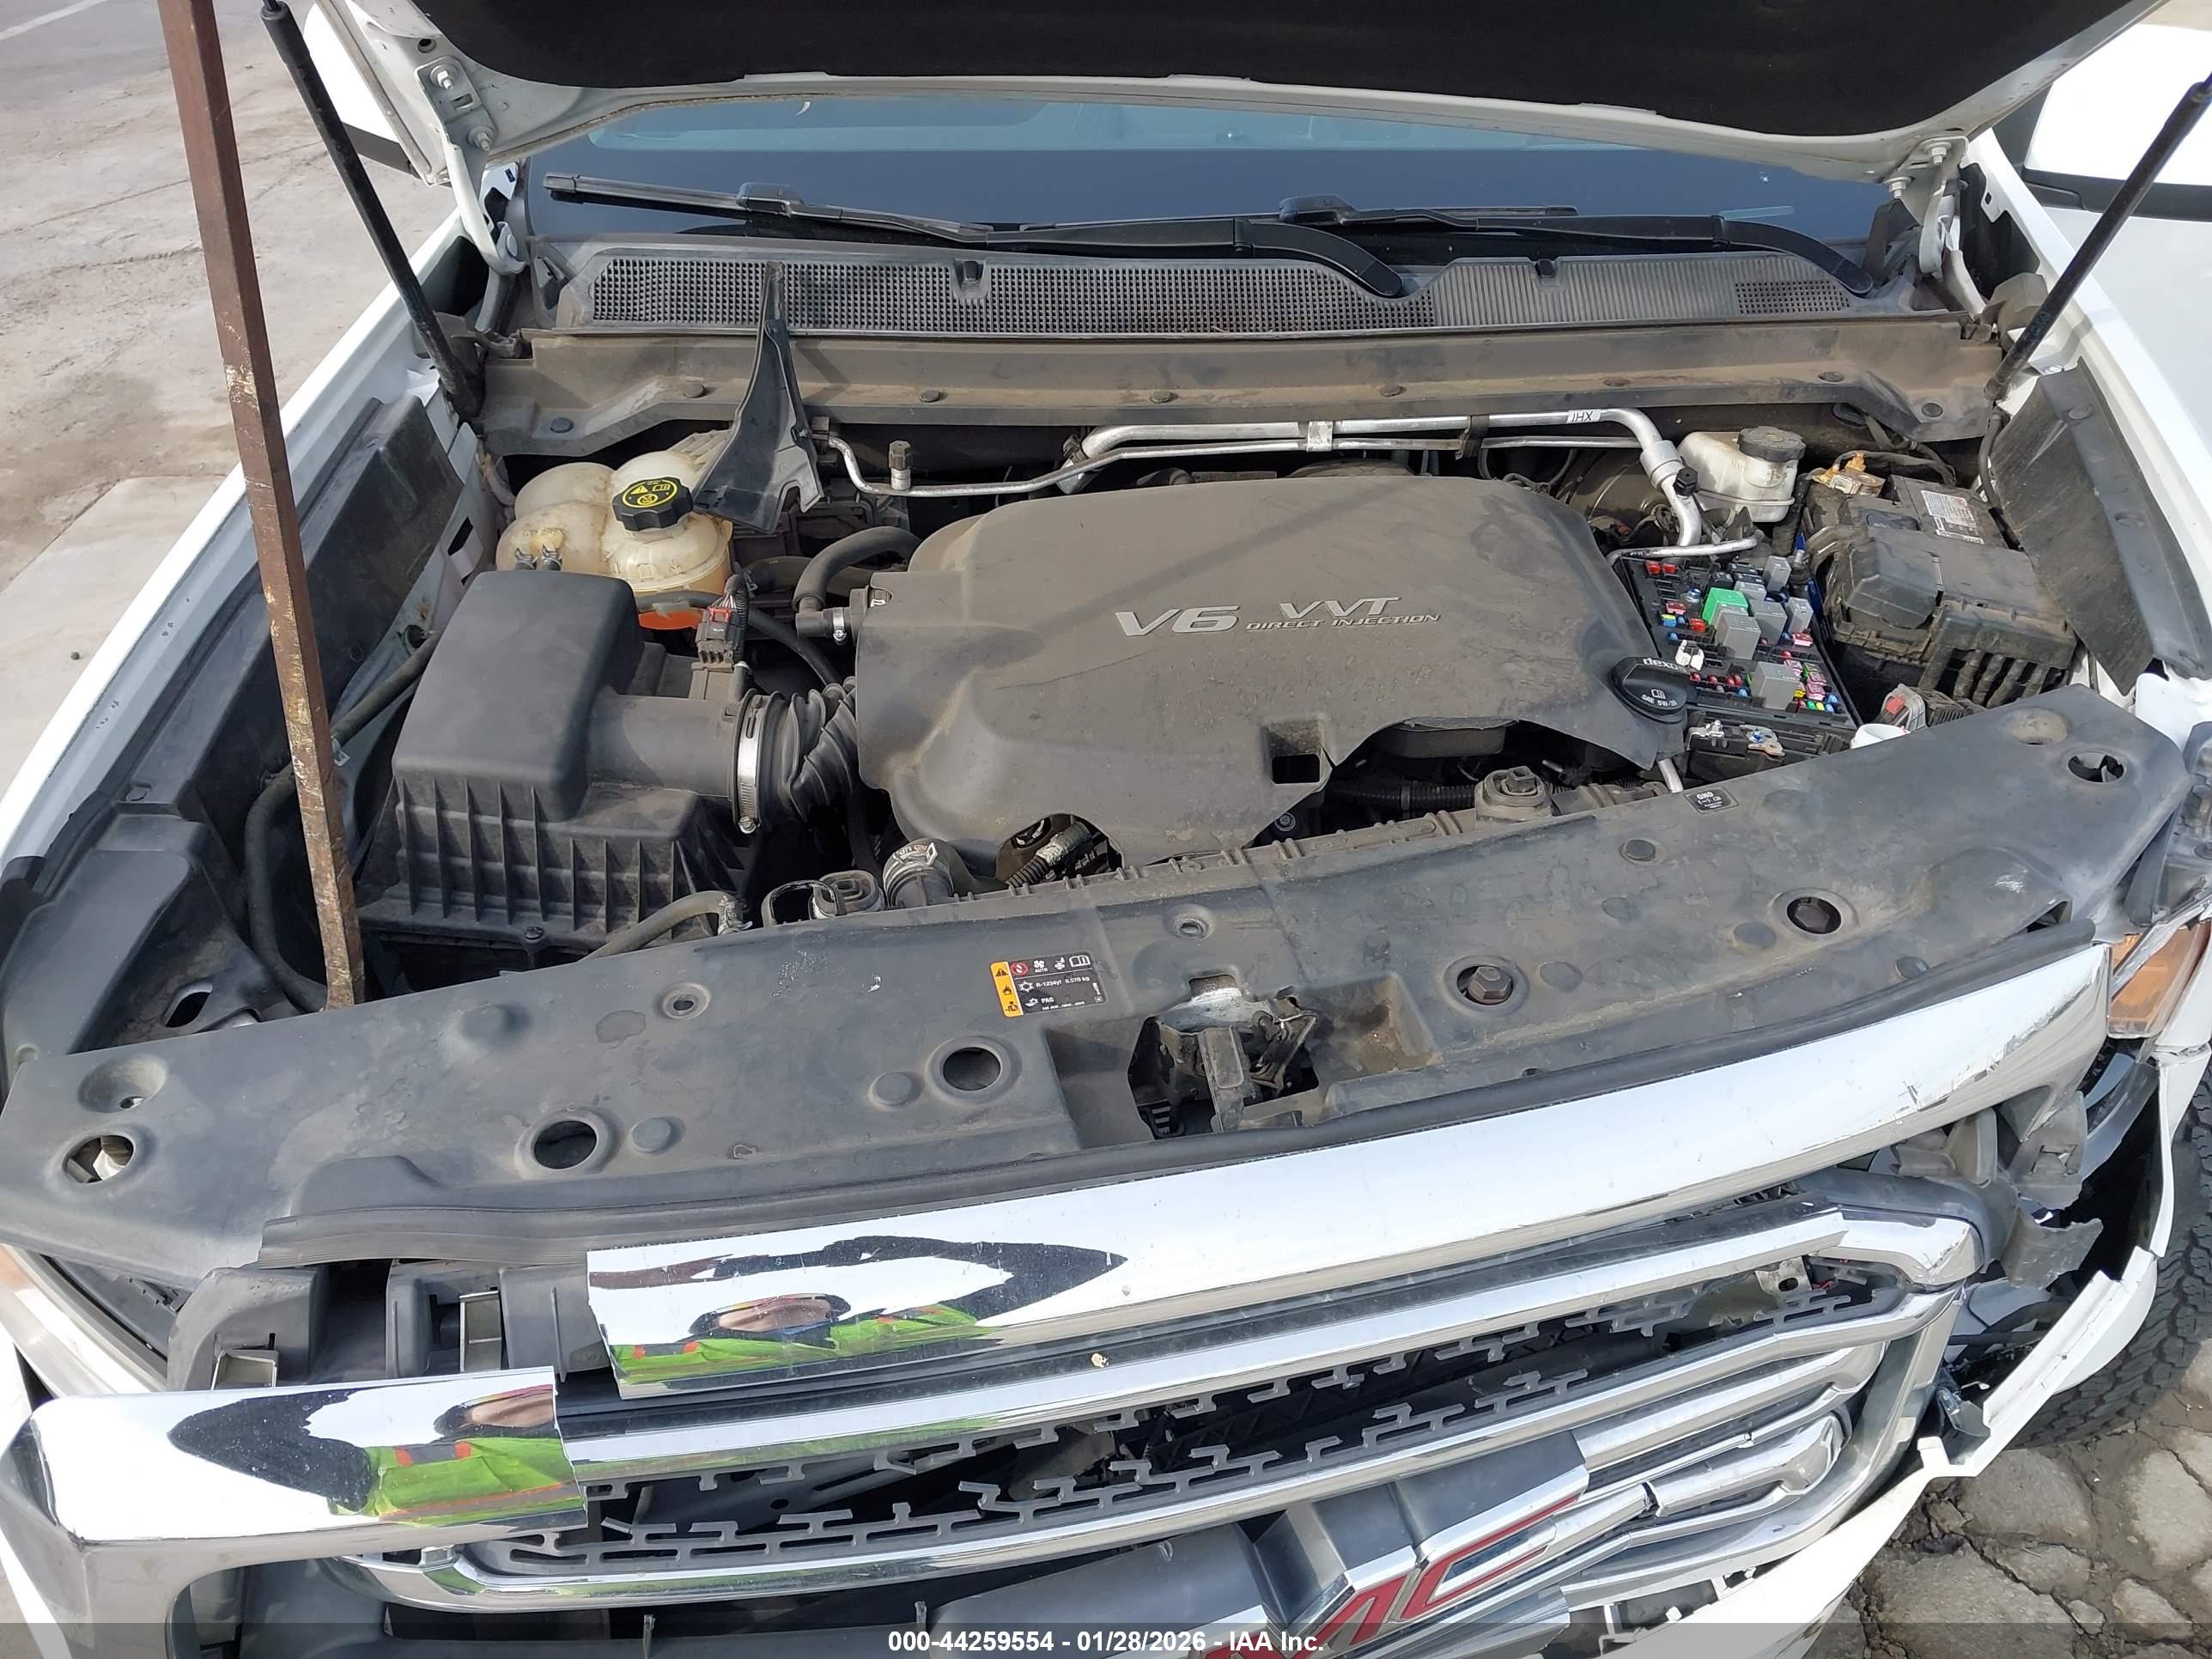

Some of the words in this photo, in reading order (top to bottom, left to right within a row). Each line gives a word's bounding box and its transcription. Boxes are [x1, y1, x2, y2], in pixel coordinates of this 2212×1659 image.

[1114, 605, 1241, 636] V6
[1279, 596, 1401, 619] VVT
[1244, 619, 1325, 631] DIRECT
[1330, 613, 1442, 628] INJECTION
[1642, 657, 1686, 672] dexos
[1641, 694, 1655, 704] SAE
[1036, 979, 1062, 988] R-1234yf
